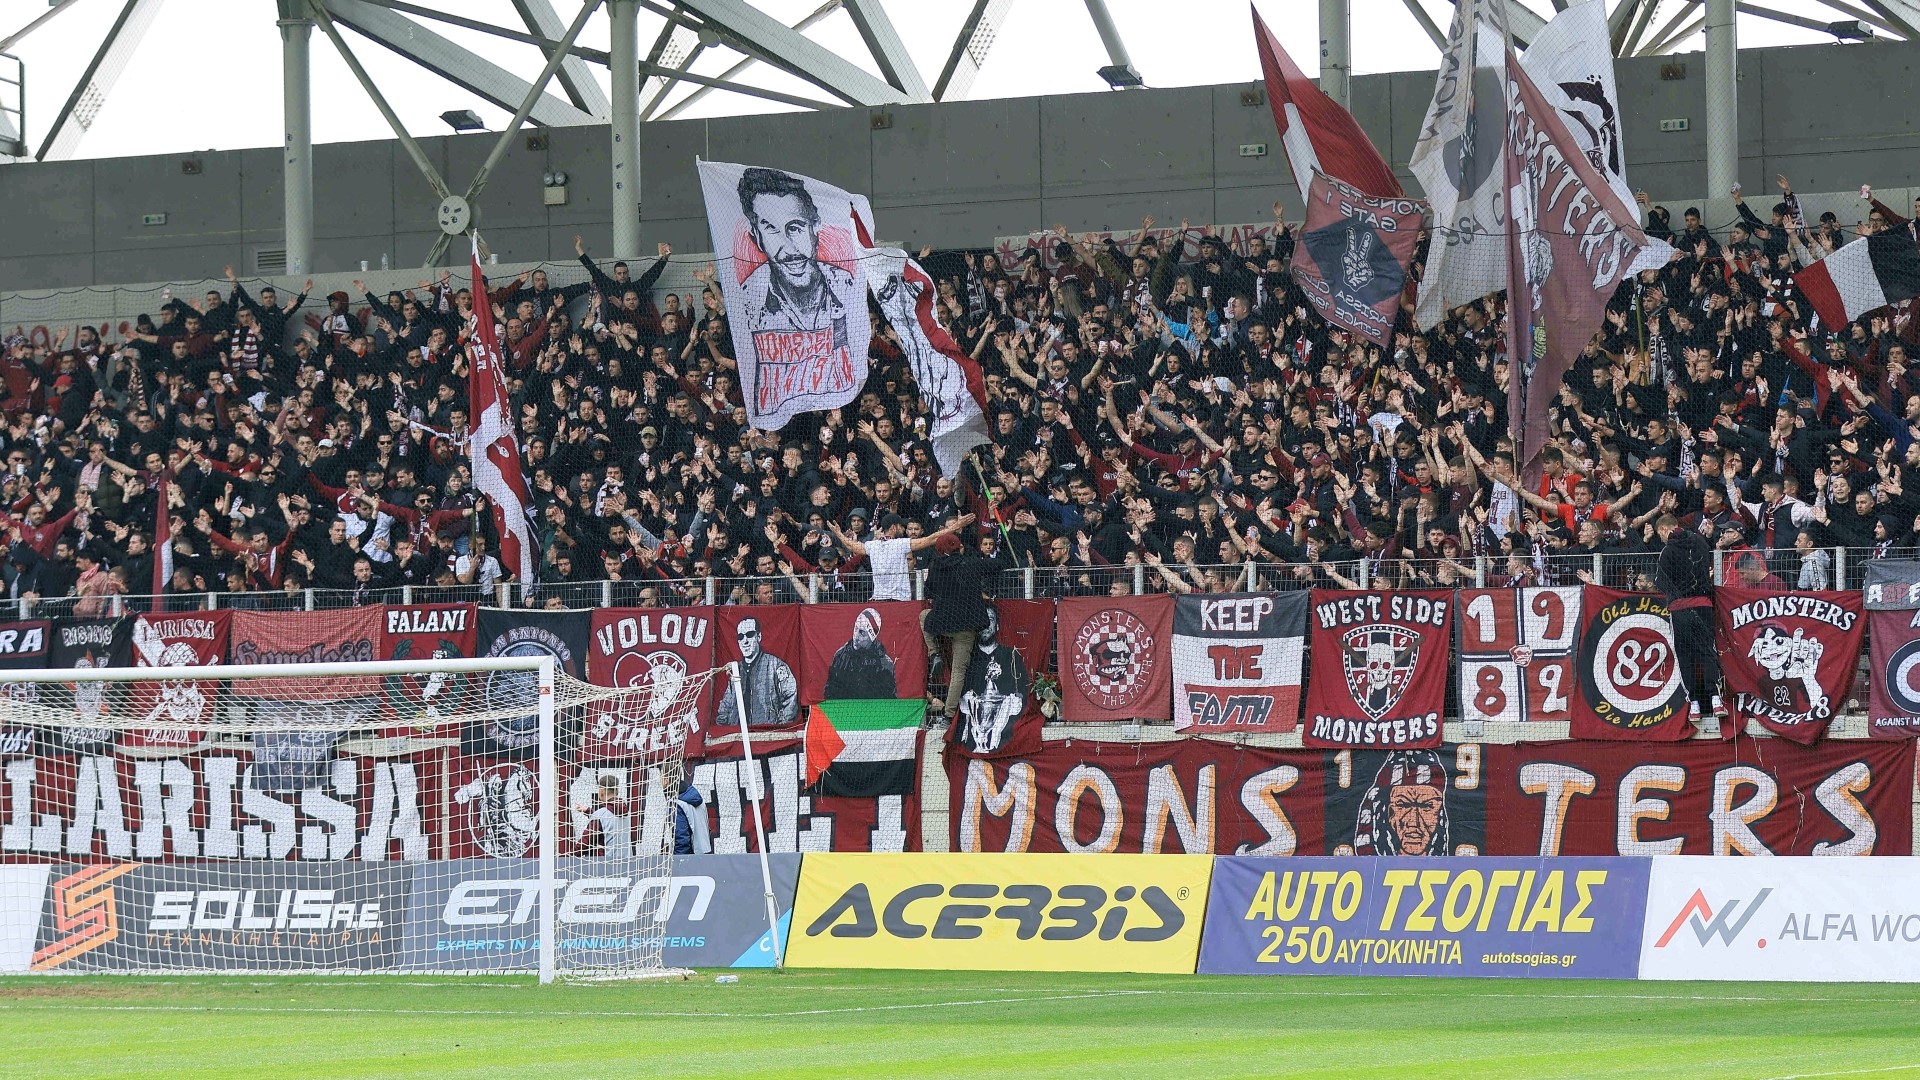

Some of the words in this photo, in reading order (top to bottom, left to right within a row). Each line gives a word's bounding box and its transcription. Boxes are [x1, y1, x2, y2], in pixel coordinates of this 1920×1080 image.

[387, 608, 469, 634] FALANI
[1201, 596, 1274, 631] KEEP
[1316, 595, 1382, 629] WEST
[1390, 594, 1448, 627] SIDE
[1601, 601, 1630, 624] Old
[1731, 596, 1857, 632] MONSTERS
[142, 618, 215, 641] LARISSA
[508, 625, 571, 662] ANTONIO
[595, 612, 709, 656] VOLOU
[1076, 610, 1154, 652] MONSTERS
[1207, 645, 1264, 680] THE
[1612, 639, 1667, 688] 82
[1074, 662, 1098, 696] KEEP
[1102, 694, 1126, 706] THE
[1128, 659, 1153, 699] FAITH
[1773, 685, 1791, 706] 82
[1188, 691, 1275, 726] FAITH
[1594, 701, 1621, 724] Die
[1875, 717, 1910, 727] AGAINST
[591, 706, 702, 751] STREET
[1311, 713, 1438, 745] MONSTERS
[0, 756, 430, 861] LARISSA
[958, 759, 1300, 856] MONS
[1517, 761, 1878, 856] TERS
[148, 890, 335, 930] SOLIS
[805, 883, 1187, 942] ACERBIS
[1245, 870, 1363, 922] AUTO
[1378, 869, 1608, 933] ΤΣΟΓΙΑΣ
[436, 939, 505, 952] EXPERTS
[510, 938, 528, 950] IN
[531, 937, 626, 950] AMINIUM
[630, 936, 706, 949] SYSTEMS
[1778, 913, 1858, 941] ALFA
[1256, 926, 1335, 964] 250
[1334, 938, 1463, 966] ΑΥΤΟΚΙΝΗΤΑ
[1481, 949, 1577, 967] autotsogias.gr
